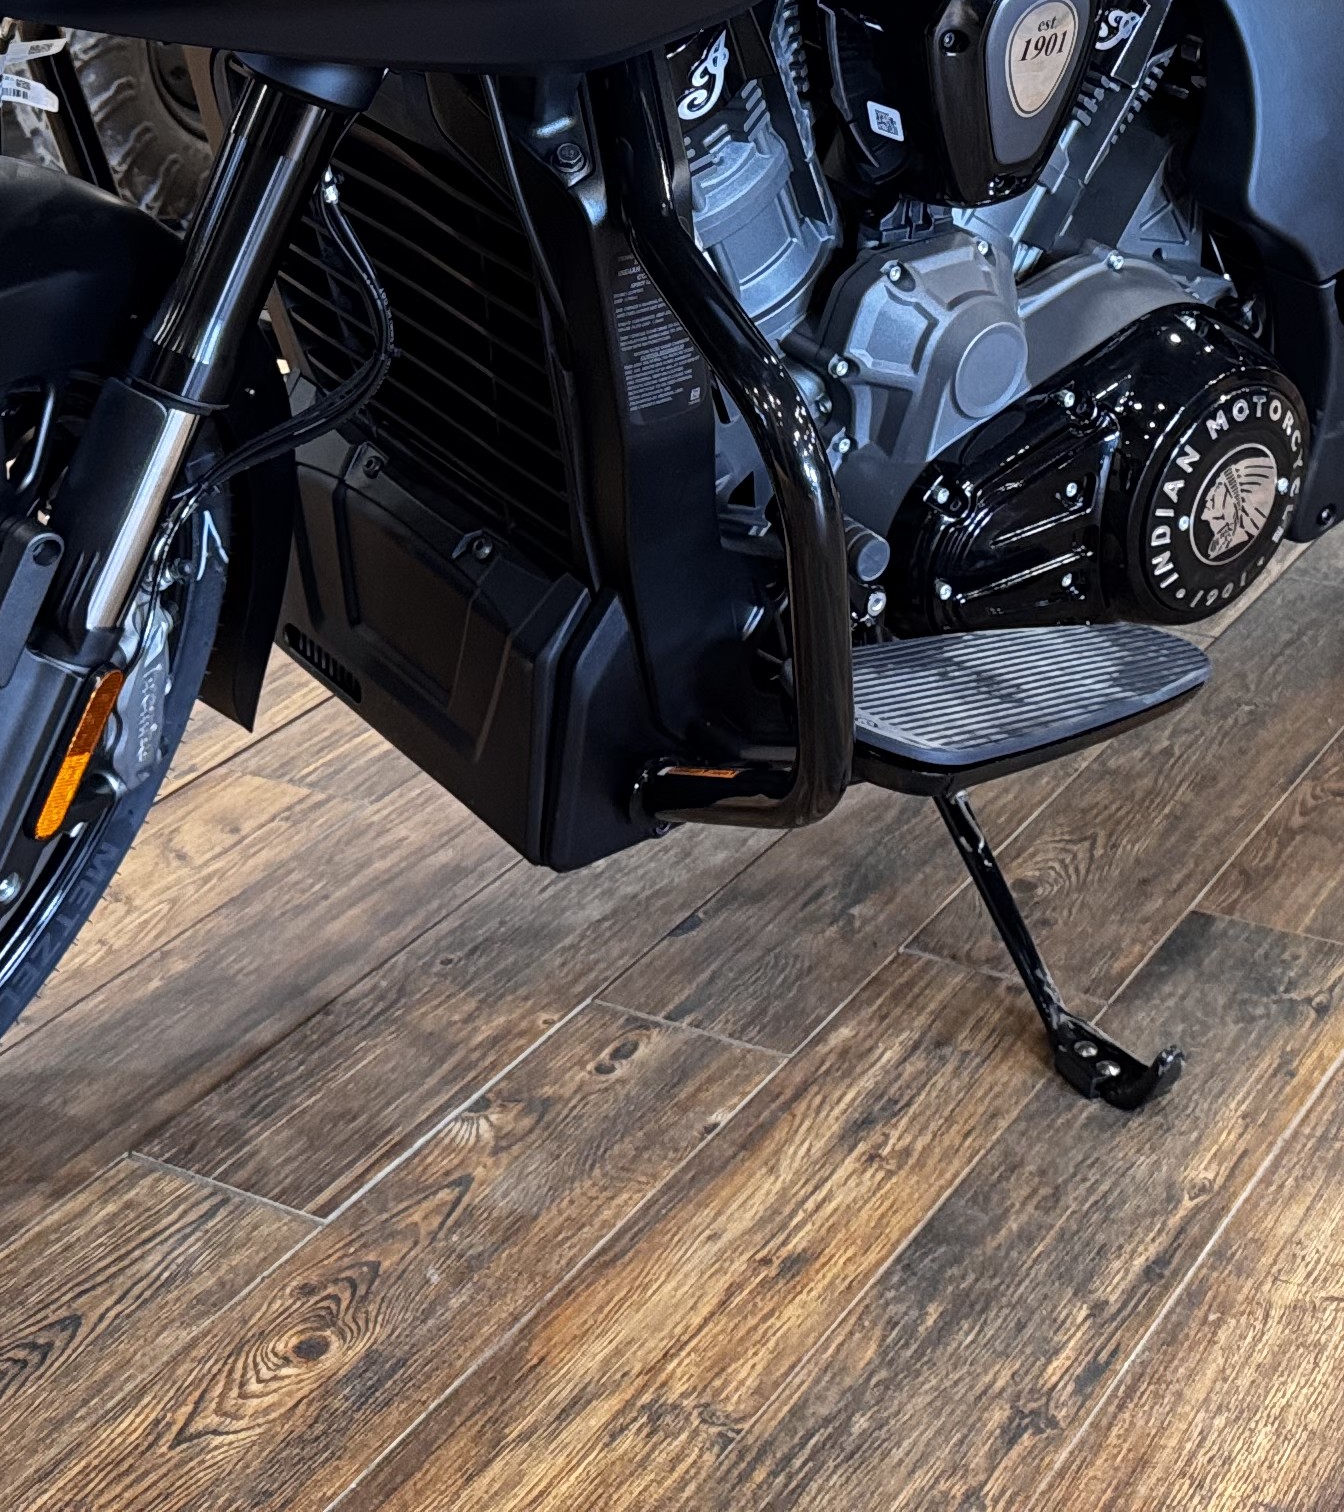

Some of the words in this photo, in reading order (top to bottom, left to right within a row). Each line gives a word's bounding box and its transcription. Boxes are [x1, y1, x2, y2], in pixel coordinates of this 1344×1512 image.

[1037, 16, 1057, 33] est
[1018, 29, 1069, 62] 1901
[1151, 444, 1202, 589] INDIAN
[1206, 394, 1305, 543] MOTORCYCLE
